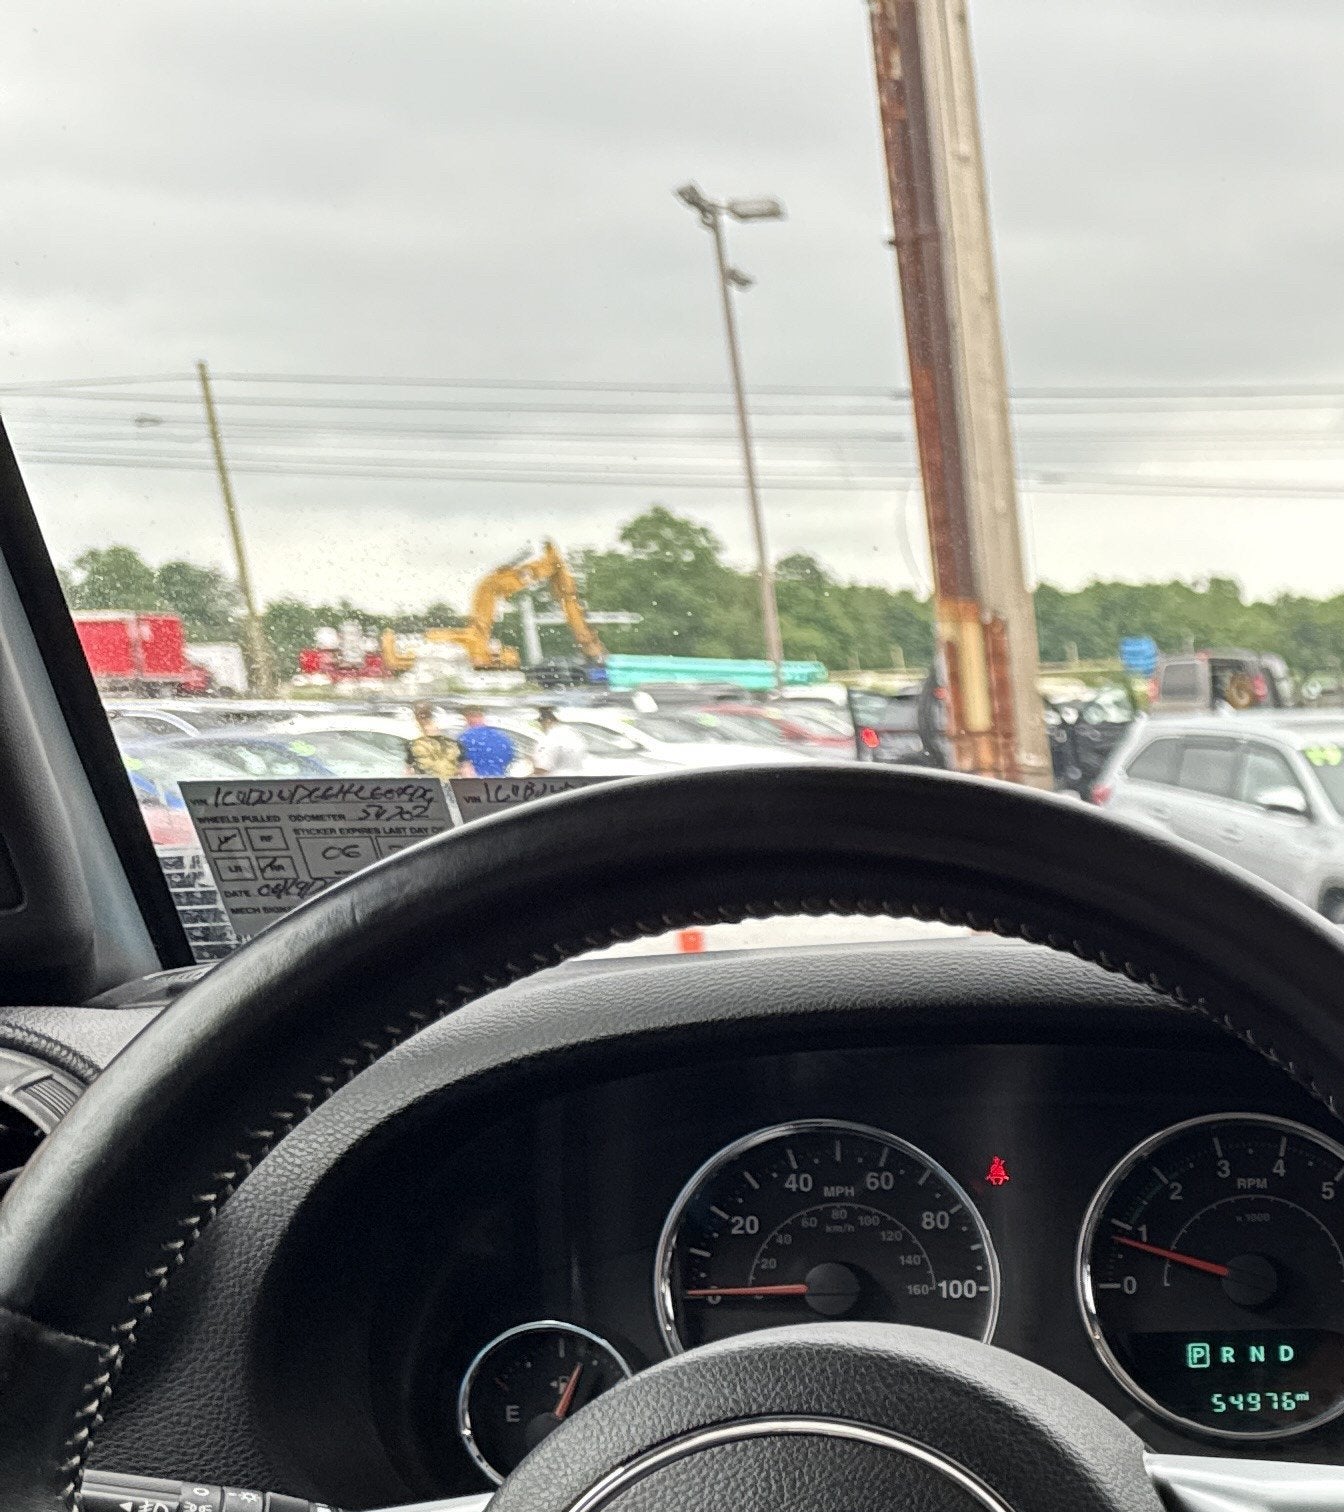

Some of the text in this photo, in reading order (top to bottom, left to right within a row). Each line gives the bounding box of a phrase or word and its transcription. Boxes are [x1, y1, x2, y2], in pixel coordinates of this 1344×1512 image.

[197, 815, 239, 824] WHEELS
[288, 813, 347, 823] ODOMETER
[383, 826, 407, 835] LAST
[410, 826, 429, 835] DAY
[223, 889, 252, 898] DATE
[1217, 1159, 1231, 1179] 3
[1272, 1159, 1287, 1178] 4
[783, 1173, 813, 1193] 40
[865, 1171, 895, 1191] 60
[1237, 1177, 1268, 1189] RPM
[823, 1186, 855, 1197] MPH
[1169, 1182, 1183, 1201] 2
[1321, 1182, 1335, 1201] 5
[731, 1215, 760, 1235] 20
[921, 1211, 950, 1231] 80
[880, 1230, 903, 1242] 120
[1138, 1224, 1149, 1242] 1
[761, 1258, 777, 1270] 20
[900, 1254, 922, 1266] 140
[907, 1284, 930, 1296] 160
[937, 1279, 977, 1299] 100
[1122, 1276, 1138, 1296] 0
[1220, 1346, 1236, 1364] R
[1249, 1345, 1266, 1363] N
[1279, 1344, 1295, 1362] D
[1210, 1391, 1296, 1413] 54976
[505, 1405, 520, 1424] E
